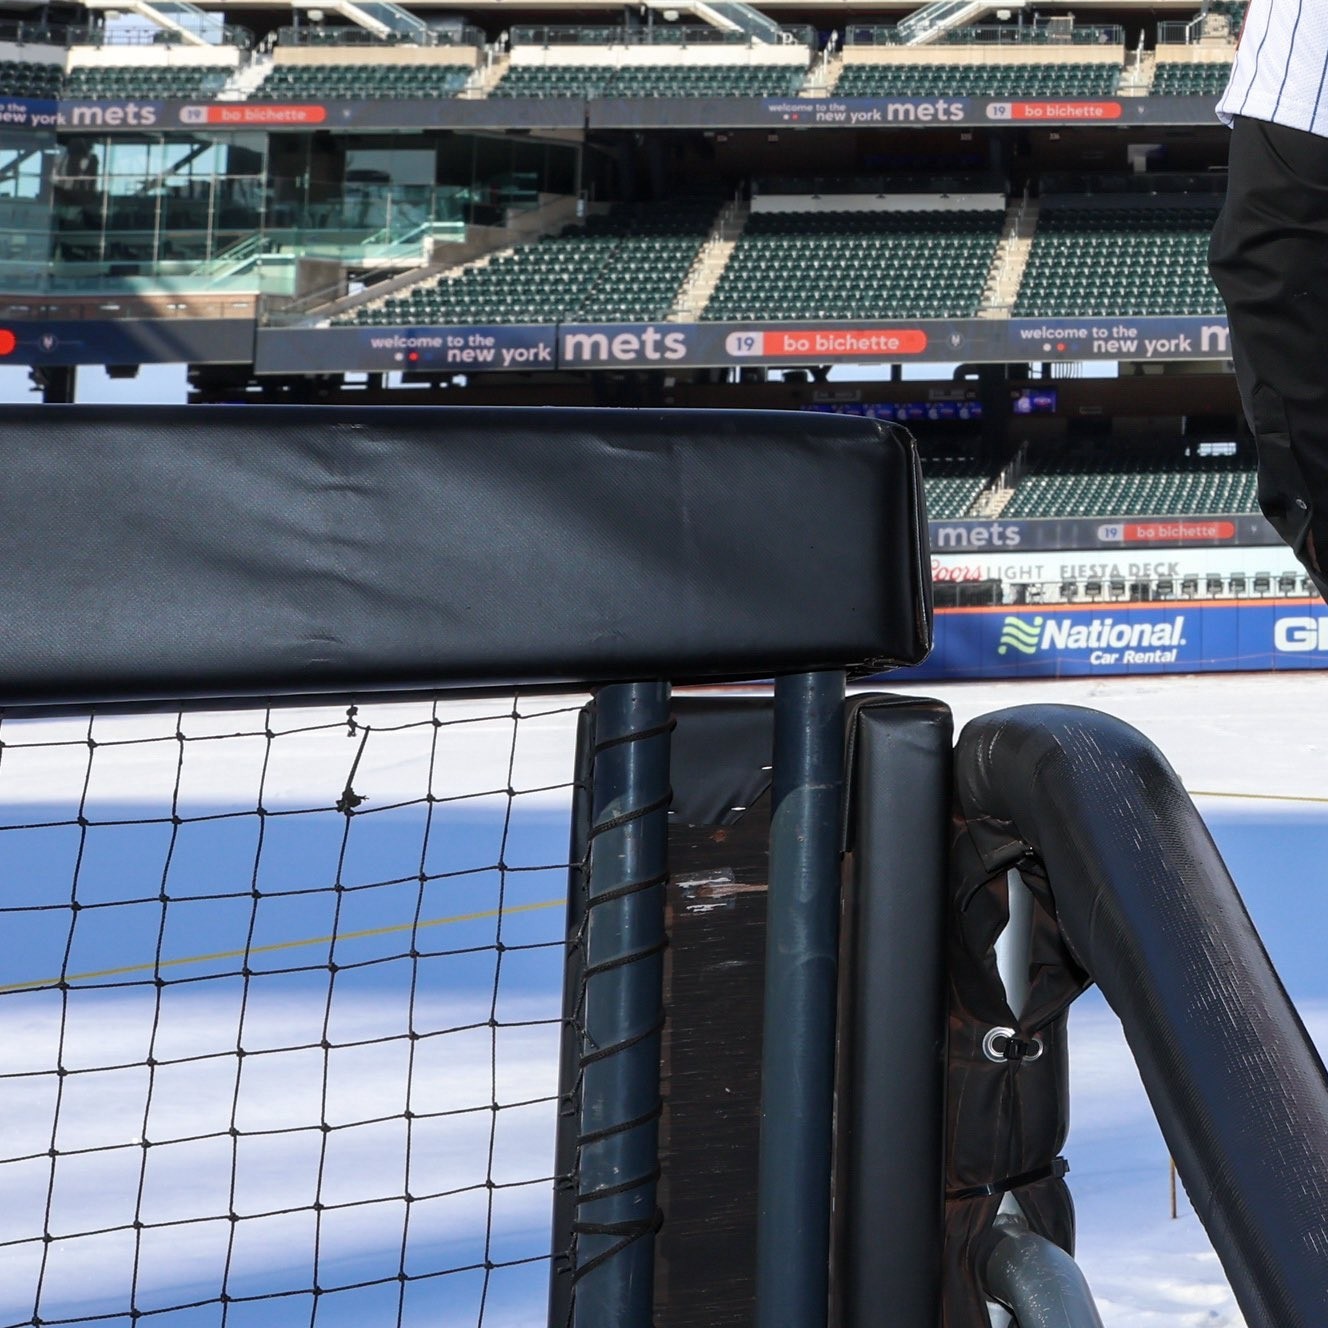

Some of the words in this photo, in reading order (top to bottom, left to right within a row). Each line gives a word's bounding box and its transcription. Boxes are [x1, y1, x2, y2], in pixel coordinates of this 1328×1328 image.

[72, 102, 156, 125] mets
[222, 107, 241, 121] bo
[244, 106, 307, 122] bichette
[768, 103, 813, 113] welcome
[816, 104, 827, 113] to
[829, 102, 847, 112] the
[887, 99, 965, 122] mets
[993, 106, 1006, 117] 19
[1024, 105, 1043, 118] bo
[1047, 104, 1104, 118] bichette
[31, 112, 67, 127] york
[816, 112, 846, 122] new
[850, 108, 882, 124] york
[1020, 325, 1088, 339] welcome
[1092, 327, 1109, 338] to
[1112, 325, 1138, 338] the
[370, 334, 442, 349] welcome
[447, 336, 464, 347] to
[468, 334, 495, 347] the
[563, 326, 687, 362] mets
[735, 337, 755, 352] 19
[783, 335, 810, 352] bo
[815, 334, 900, 352] bichette
[1093, 339, 1144, 354] new
[1144, 334, 1192, 357] york
[447, 348, 494, 363] new
[501, 343, 552, 366] york
[937, 521, 1022, 547] mets
[1103, 527, 1119, 539] 19
[1136, 525, 1155, 538] bo
[1158, 524, 1217, 539] bichette
[986, 565, 1045, 581] LIGHT
[1059, 563, 1120, 579] FIESTA
[1128, 561, 1180, 578] DECK
[1090, 651, 1119, 665] Car
[1122, 648, 1177, 664] Rental
